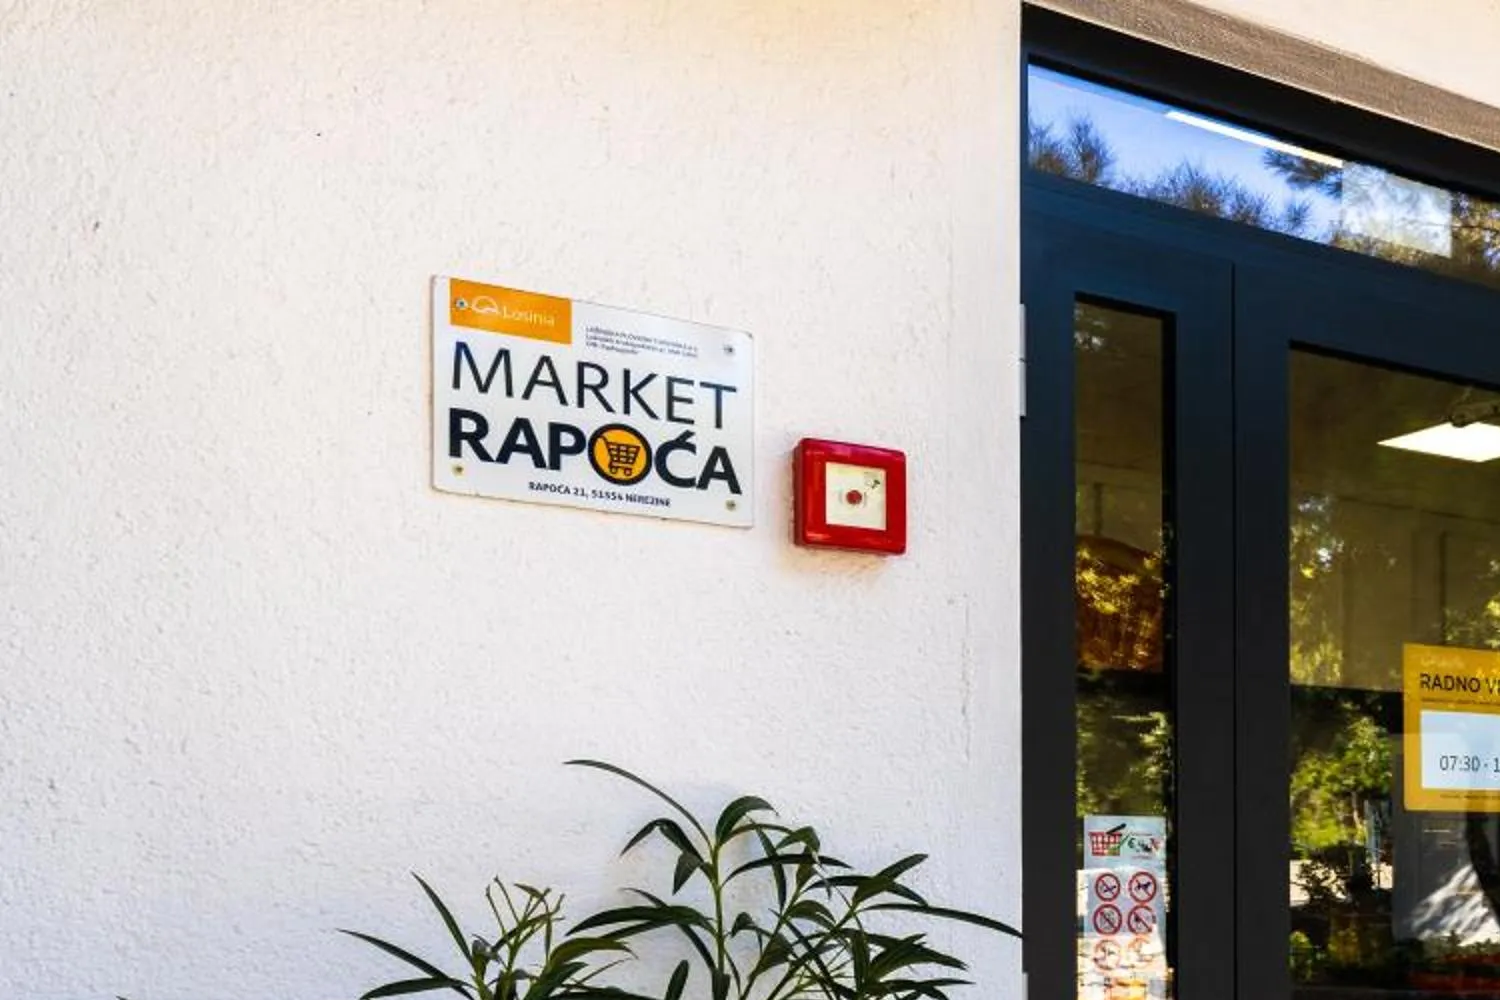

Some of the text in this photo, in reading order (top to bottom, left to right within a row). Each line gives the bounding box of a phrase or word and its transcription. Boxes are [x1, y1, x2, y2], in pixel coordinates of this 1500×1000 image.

[452, 341, 737, 429] MARKET
[448, 408, 742, 495] RAPOĆA
[1420, 673, 1481, 693] RADNO
[1439, 755, 1481, 772] 07:30
